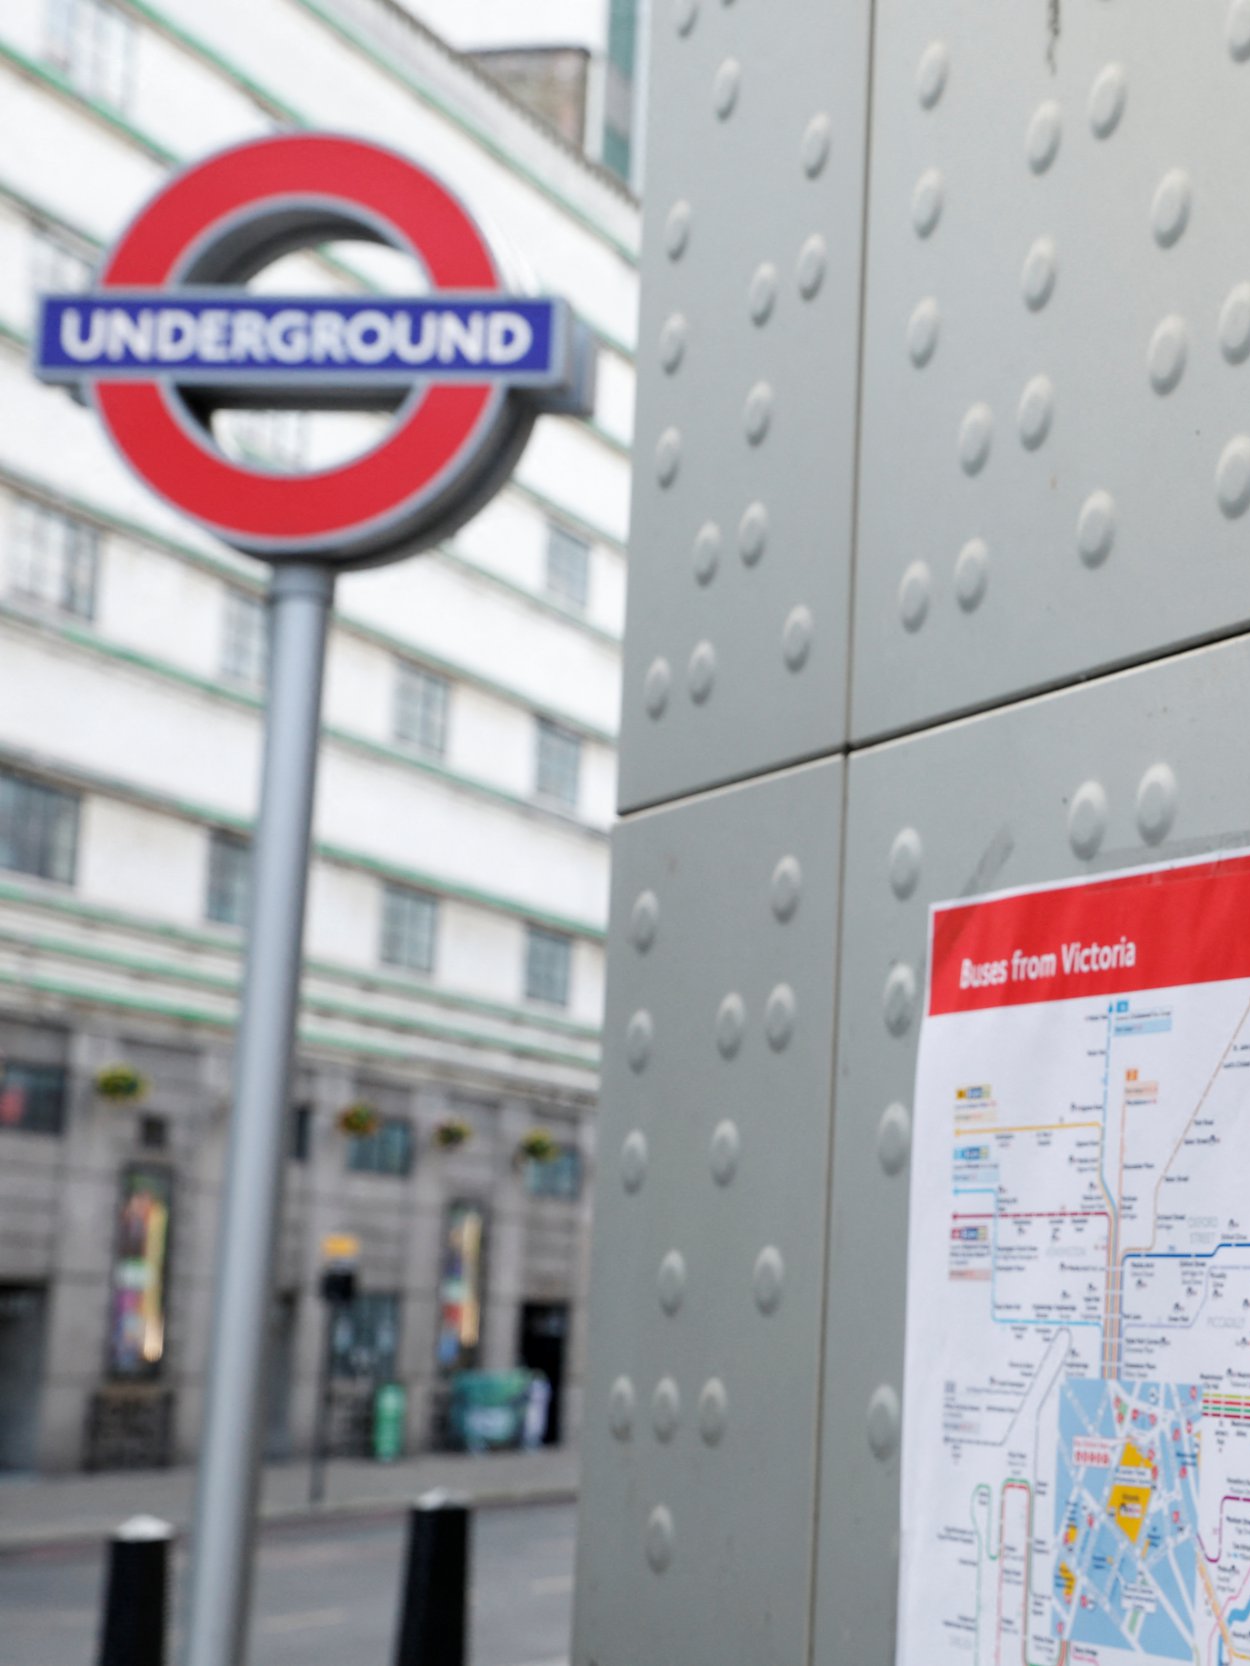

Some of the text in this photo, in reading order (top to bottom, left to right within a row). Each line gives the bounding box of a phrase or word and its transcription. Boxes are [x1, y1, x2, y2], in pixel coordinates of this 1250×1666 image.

[60, 307, 532, 364] UNDERGROUND
[960, 941, 1136, 989] Buses from Victoria
